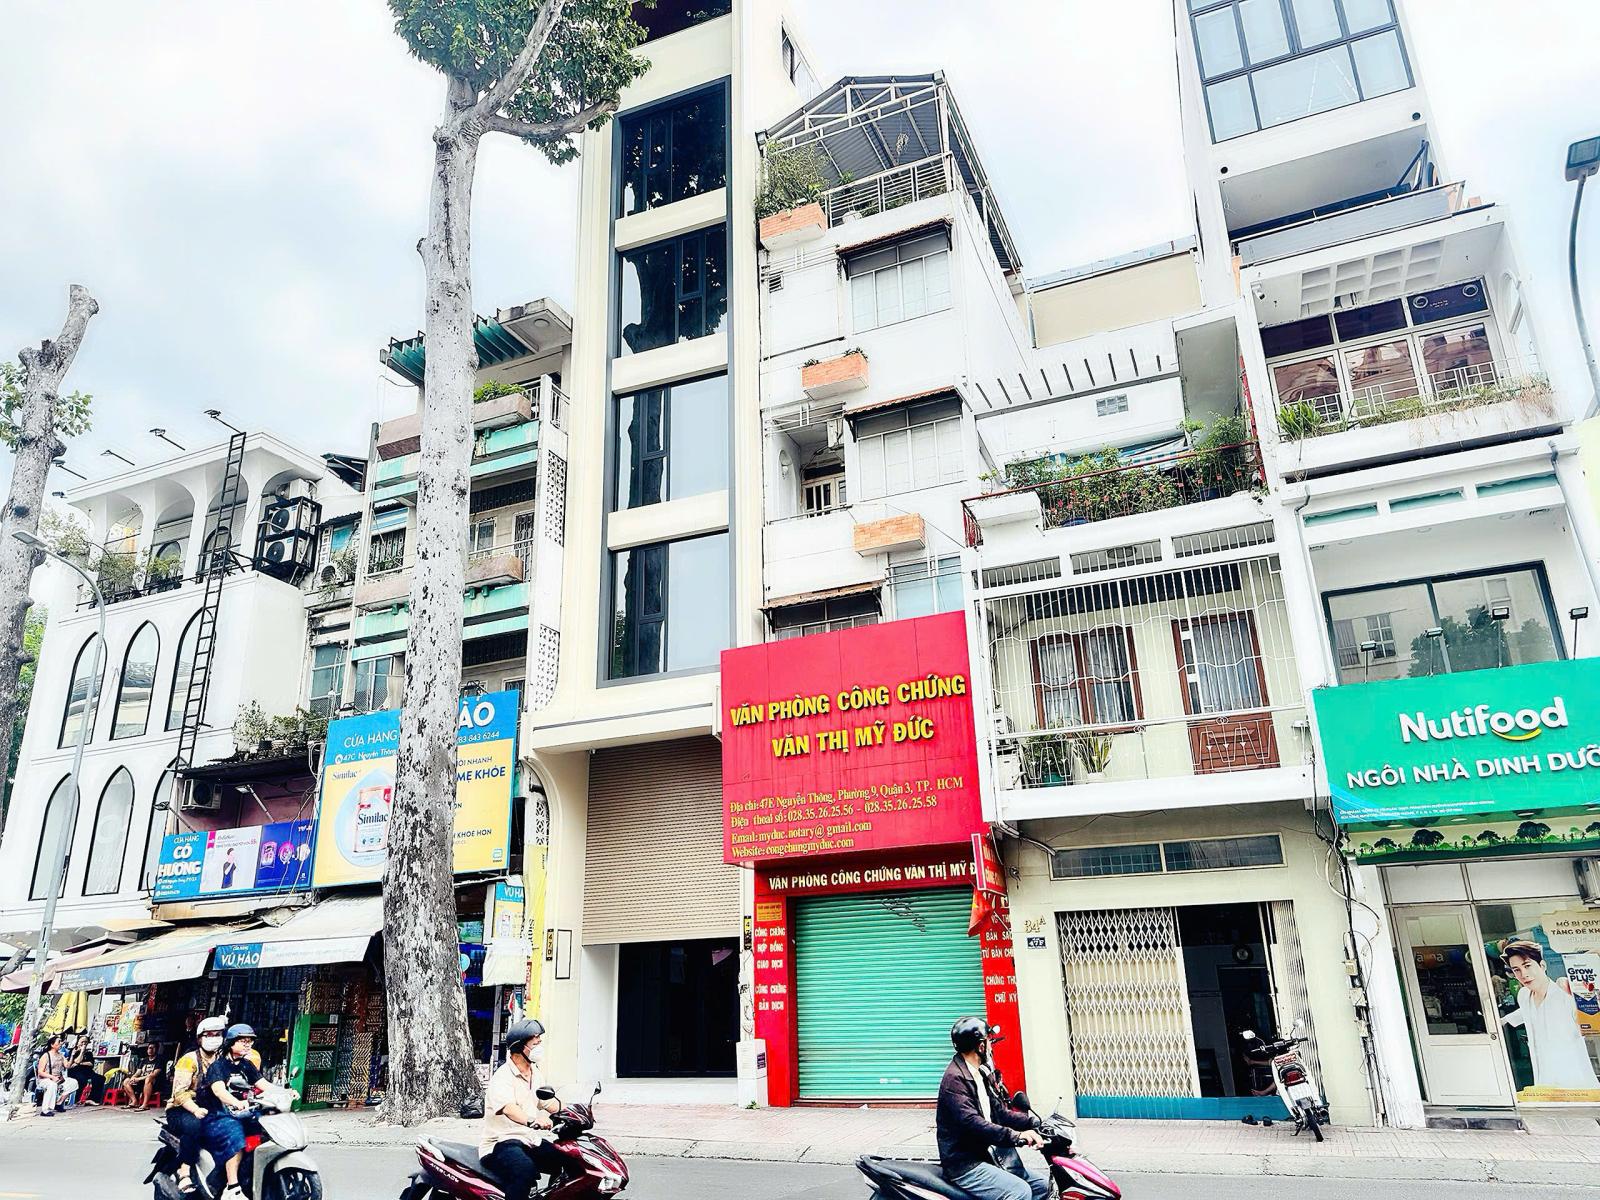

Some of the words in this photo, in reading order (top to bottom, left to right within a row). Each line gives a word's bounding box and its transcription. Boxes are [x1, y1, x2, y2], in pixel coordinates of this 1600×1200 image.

[730, 702, 764, 726] VĂN
[768, 694, 830, 721] PHÒNG
[837, 685, 889, 711] CÔNG
[897, 673, 966, 703] CHỨNG
[1399, 696, 1569, 743] Nutifood
[482, 730, 500, 739] 6244
[772, 733, 810, 757] VĂN
[816, 729, 849, 753] THỊ
[854, 719, 885, 747] MỸ
[893, 714, 935, 742] ĐỨC
[1346, 763, 1406, 789] NGÔI
[1412, 757, 1471, 783] NHÀ
[1475, 754, 1542, 777] DINH
[1546, 743, 1600, 771] DƯỠ
[730, 801, 743, 814] Địa
[776, 792, 806, 809] Nguyễn
[808, 792, 836, 804] Thông,
[837, 788, 870, 801] Phường
[871, 785, 879, 798] 9,
[880, 783, 903, 798] Quận
[904, 782, 914, 795] 3,
[915, 780, 933, 793] TP.
[936, 776, 963, 790] HCM
[357, 812, 389, 825] Similac
[730, 816, 749, 829] Điện
[864, 795, 938, 813] 028.35.26.25.58
[173, 843, 193, 860] CÔ
[769, 875, 788, 890] VĂN
[791, 871, 828, 889] PHÒNG
[831, 868, 861, 885] CÔNG
[864, 865, 902, 883] CHỨNG
[904, 864, 925, 880] VĂN
[928, 861, 947, 880] THỊ
[949, 860, 967, 877] MỸ
[754, 926, 768, 937] CÔNG
[985, 929, 998, 941] BẢN
[991, 945, 1003, 958] BẢN
[771, 959, 784, 971] DỊCH
[1567, 967, 1594, 975] Grow
[985, 974, 1005, 986] CHỨNG
